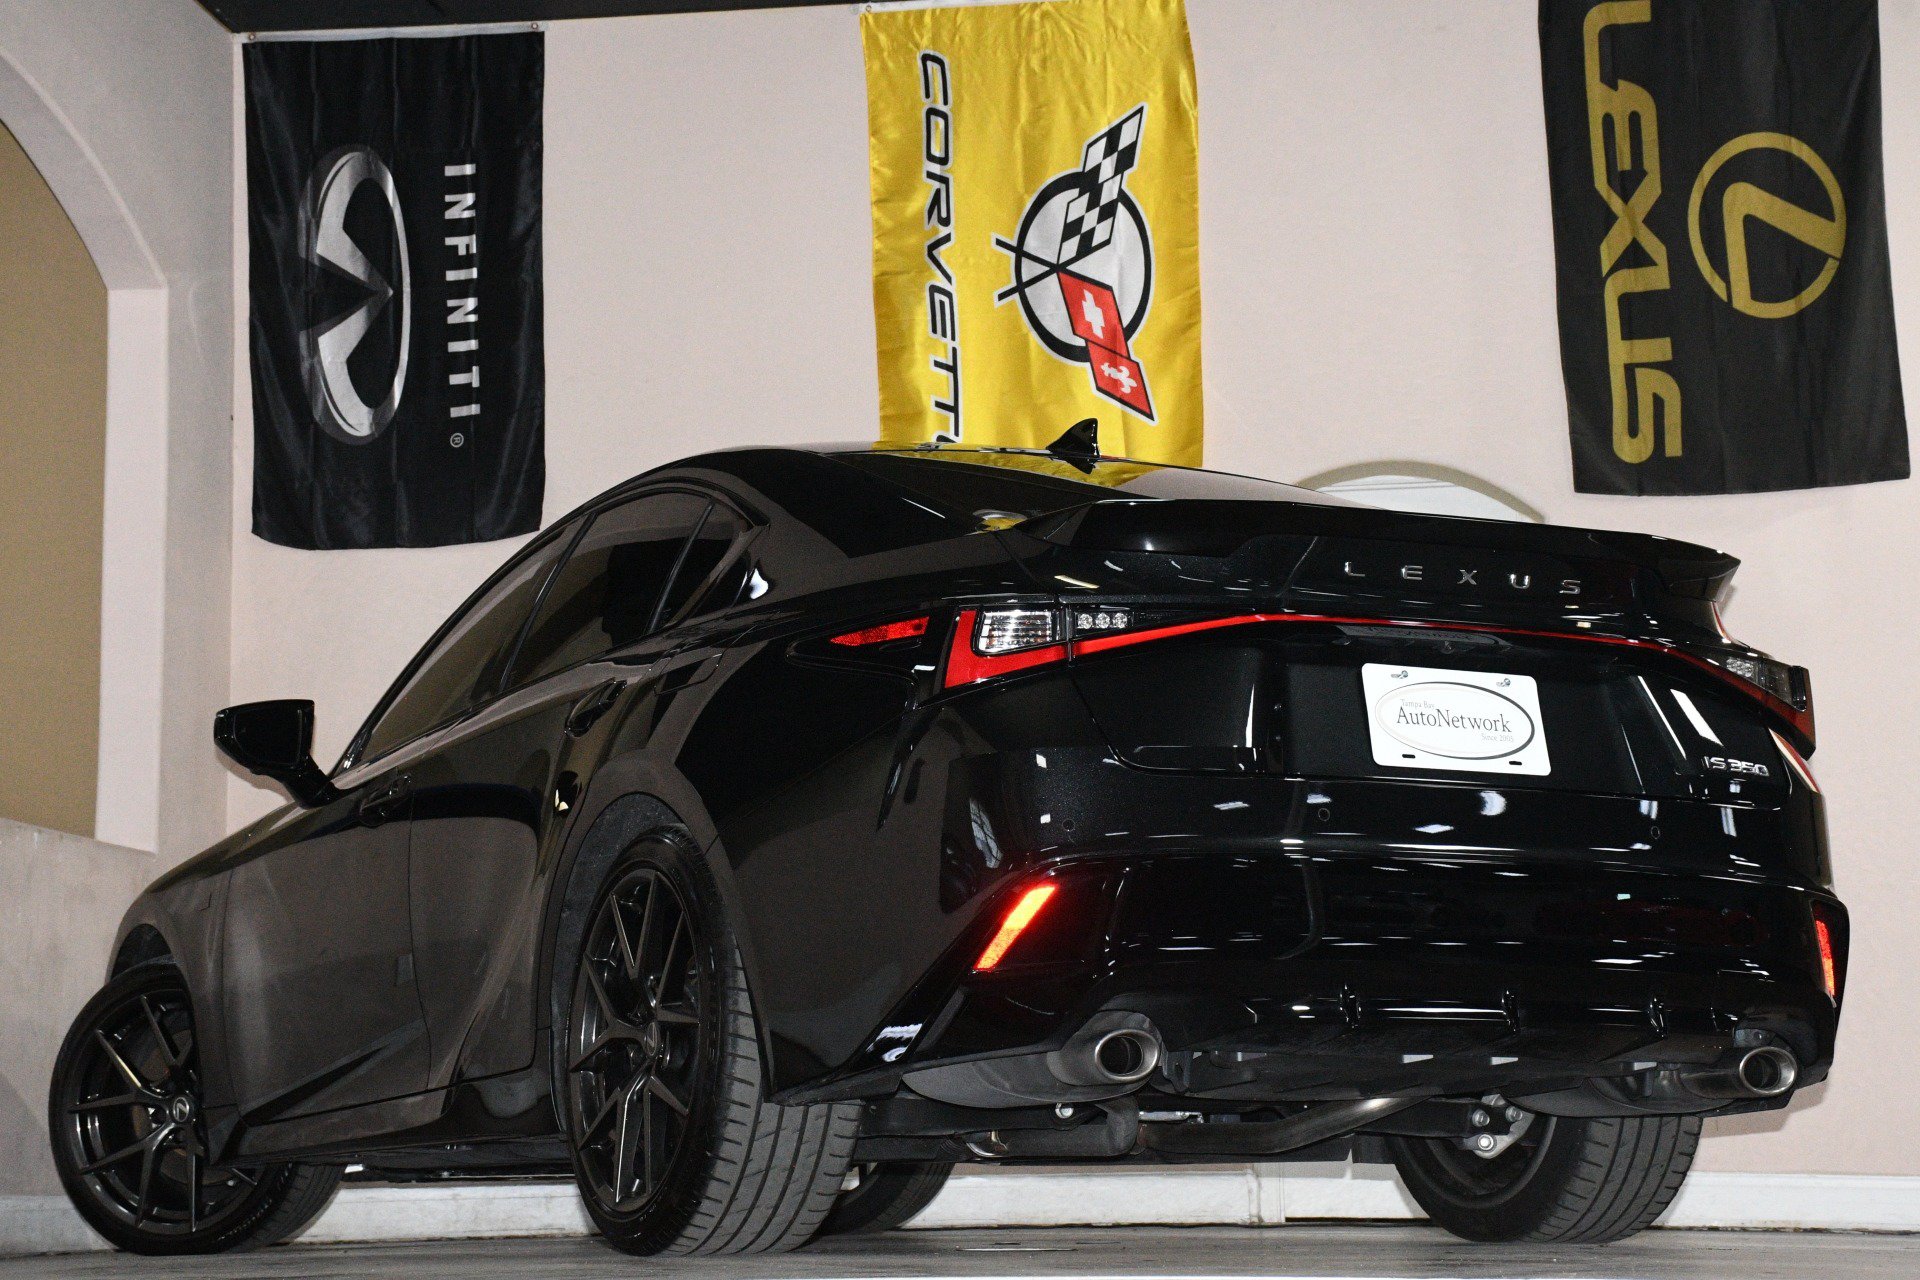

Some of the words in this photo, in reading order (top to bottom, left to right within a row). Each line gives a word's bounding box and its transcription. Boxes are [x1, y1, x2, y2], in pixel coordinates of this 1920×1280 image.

[1583, 0, 1683, 464] LEXUS
[445, 163, 480, 418] INFINITI
[1344, 561, 1581, 595] LEXUS
[1397, 706, 1512, 733] AutoNetwork
[1702, 756, 1727, 771] IS
[1727, 758, 1770, 777] 350
